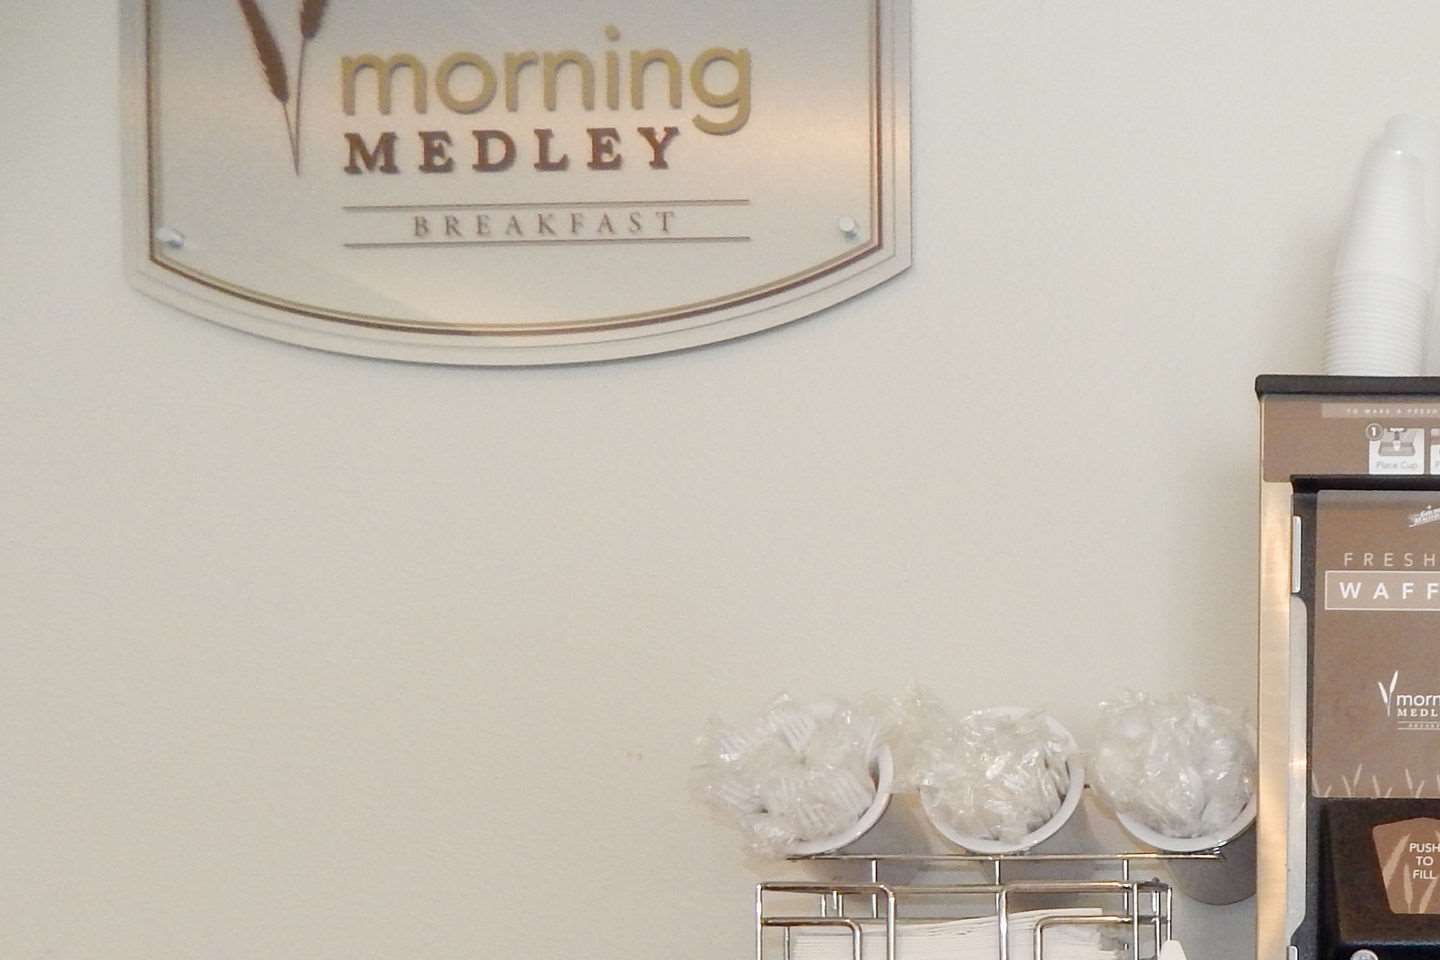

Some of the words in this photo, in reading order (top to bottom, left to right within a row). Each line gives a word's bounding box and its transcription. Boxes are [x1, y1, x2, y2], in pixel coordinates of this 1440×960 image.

[341, 23, 752, 136] morning
[343, 126, 680, 174] MEDLEY
[413, 210, 676, 237] BREAKFAST
[1343, 552, 1436, 567] FRESH
[1409, 842, 1440, 853] PUSH
[1415, 855, 1434, 866] TO
[1412, 869, 1438, 880] FILL
